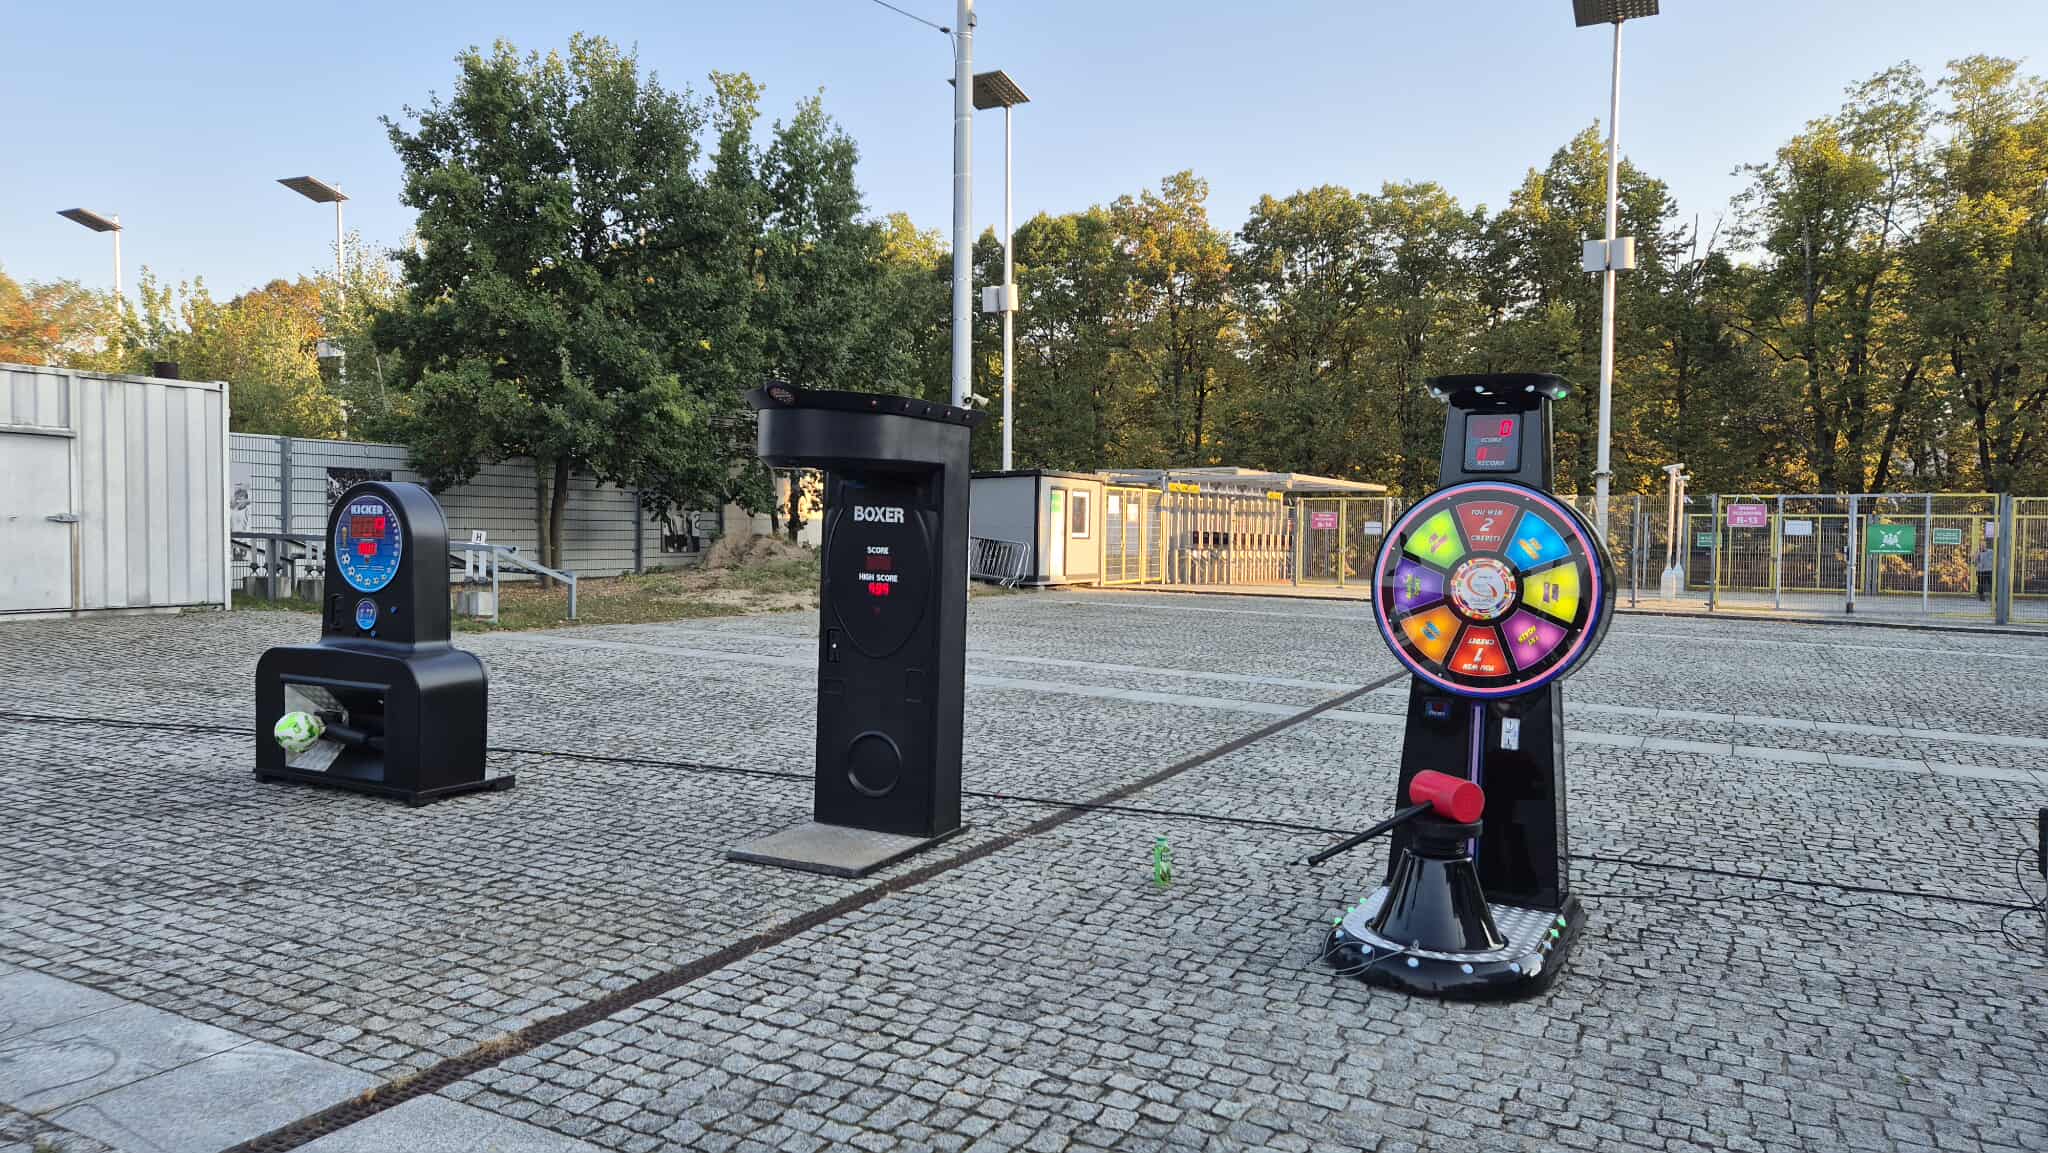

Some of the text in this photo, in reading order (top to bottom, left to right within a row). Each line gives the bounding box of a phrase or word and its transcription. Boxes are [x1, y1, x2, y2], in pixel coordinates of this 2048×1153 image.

[1499, 419, 1514, 438] 0
[351, 504, 384, 515] KICKER
[853, 506, 905, 524] BOXER
[1479, 517, 1495, 532] 2
[867, 546, 889, 555] SCORE
[858, 572, 898, 583] HIGH SCORE
[1473, 647, 1484, 663] 1
